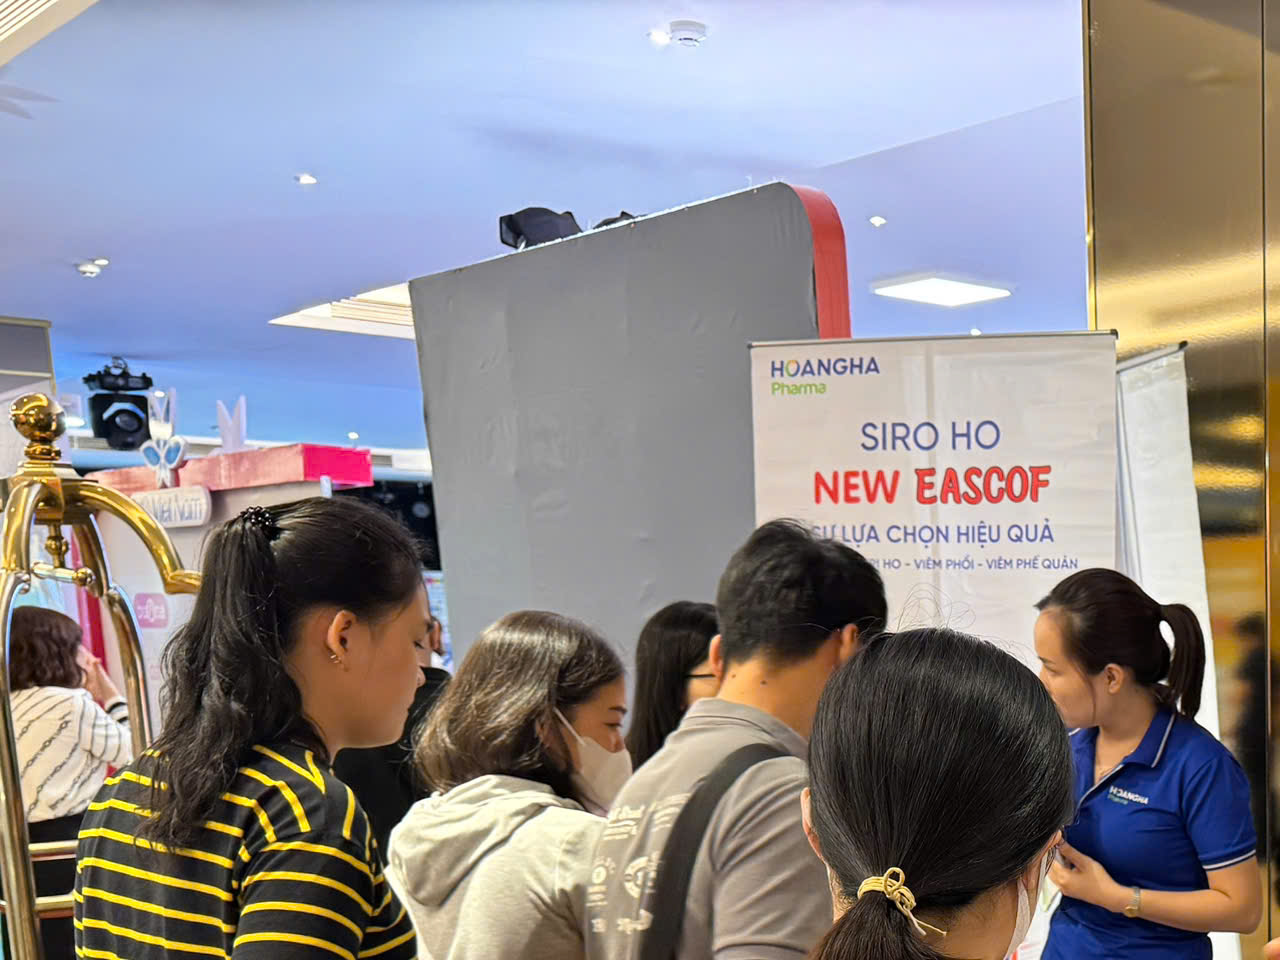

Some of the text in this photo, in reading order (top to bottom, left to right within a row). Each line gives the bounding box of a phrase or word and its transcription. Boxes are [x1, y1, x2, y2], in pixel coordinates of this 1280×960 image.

[770, 357, 880, 377] HOANGHA
[771, 381, 827, 396] Pharma
[861, 420, 1001, 451] SIRO HO
[814, 465, 1052, 505] NEW EASCOF
[887, 525, 949, 548] CHỌN
[957, 520, 1000, 548] HIỆU
[1007, 518, 1054, 543] QUẢ
[883, 559, 900, 570] HO
[914, 556, 942, 570] VIÊM
[986, 556, 1013, 570] VIÊM
[1016, 555, 1040, 569] PHẾ
[1042, 555, 1078, 569] QUẢN
